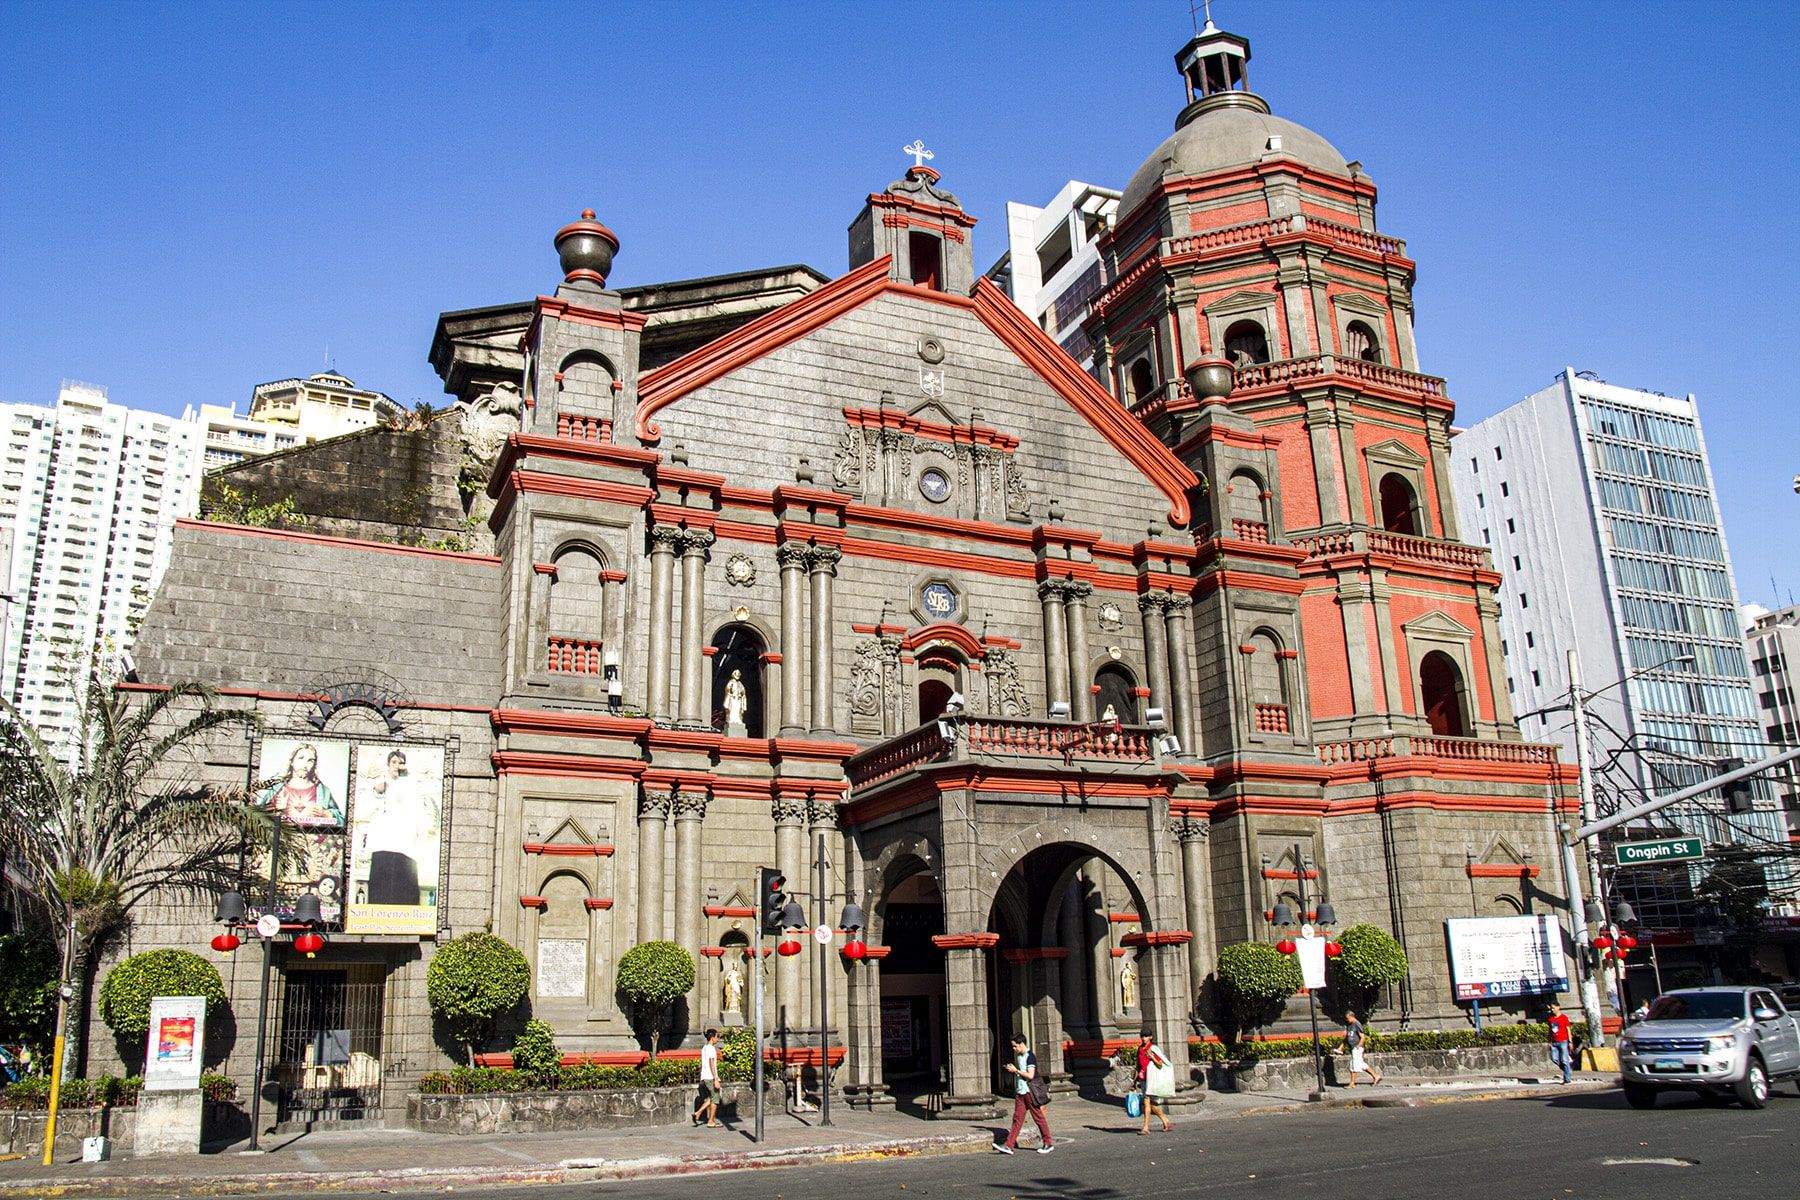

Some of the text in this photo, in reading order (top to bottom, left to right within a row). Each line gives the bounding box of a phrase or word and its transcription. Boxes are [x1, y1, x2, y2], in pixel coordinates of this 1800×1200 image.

[1626, 842, 1689, 859] Ongpin St
[350, 908, 433, 918] San Lorenzo Ruiz
